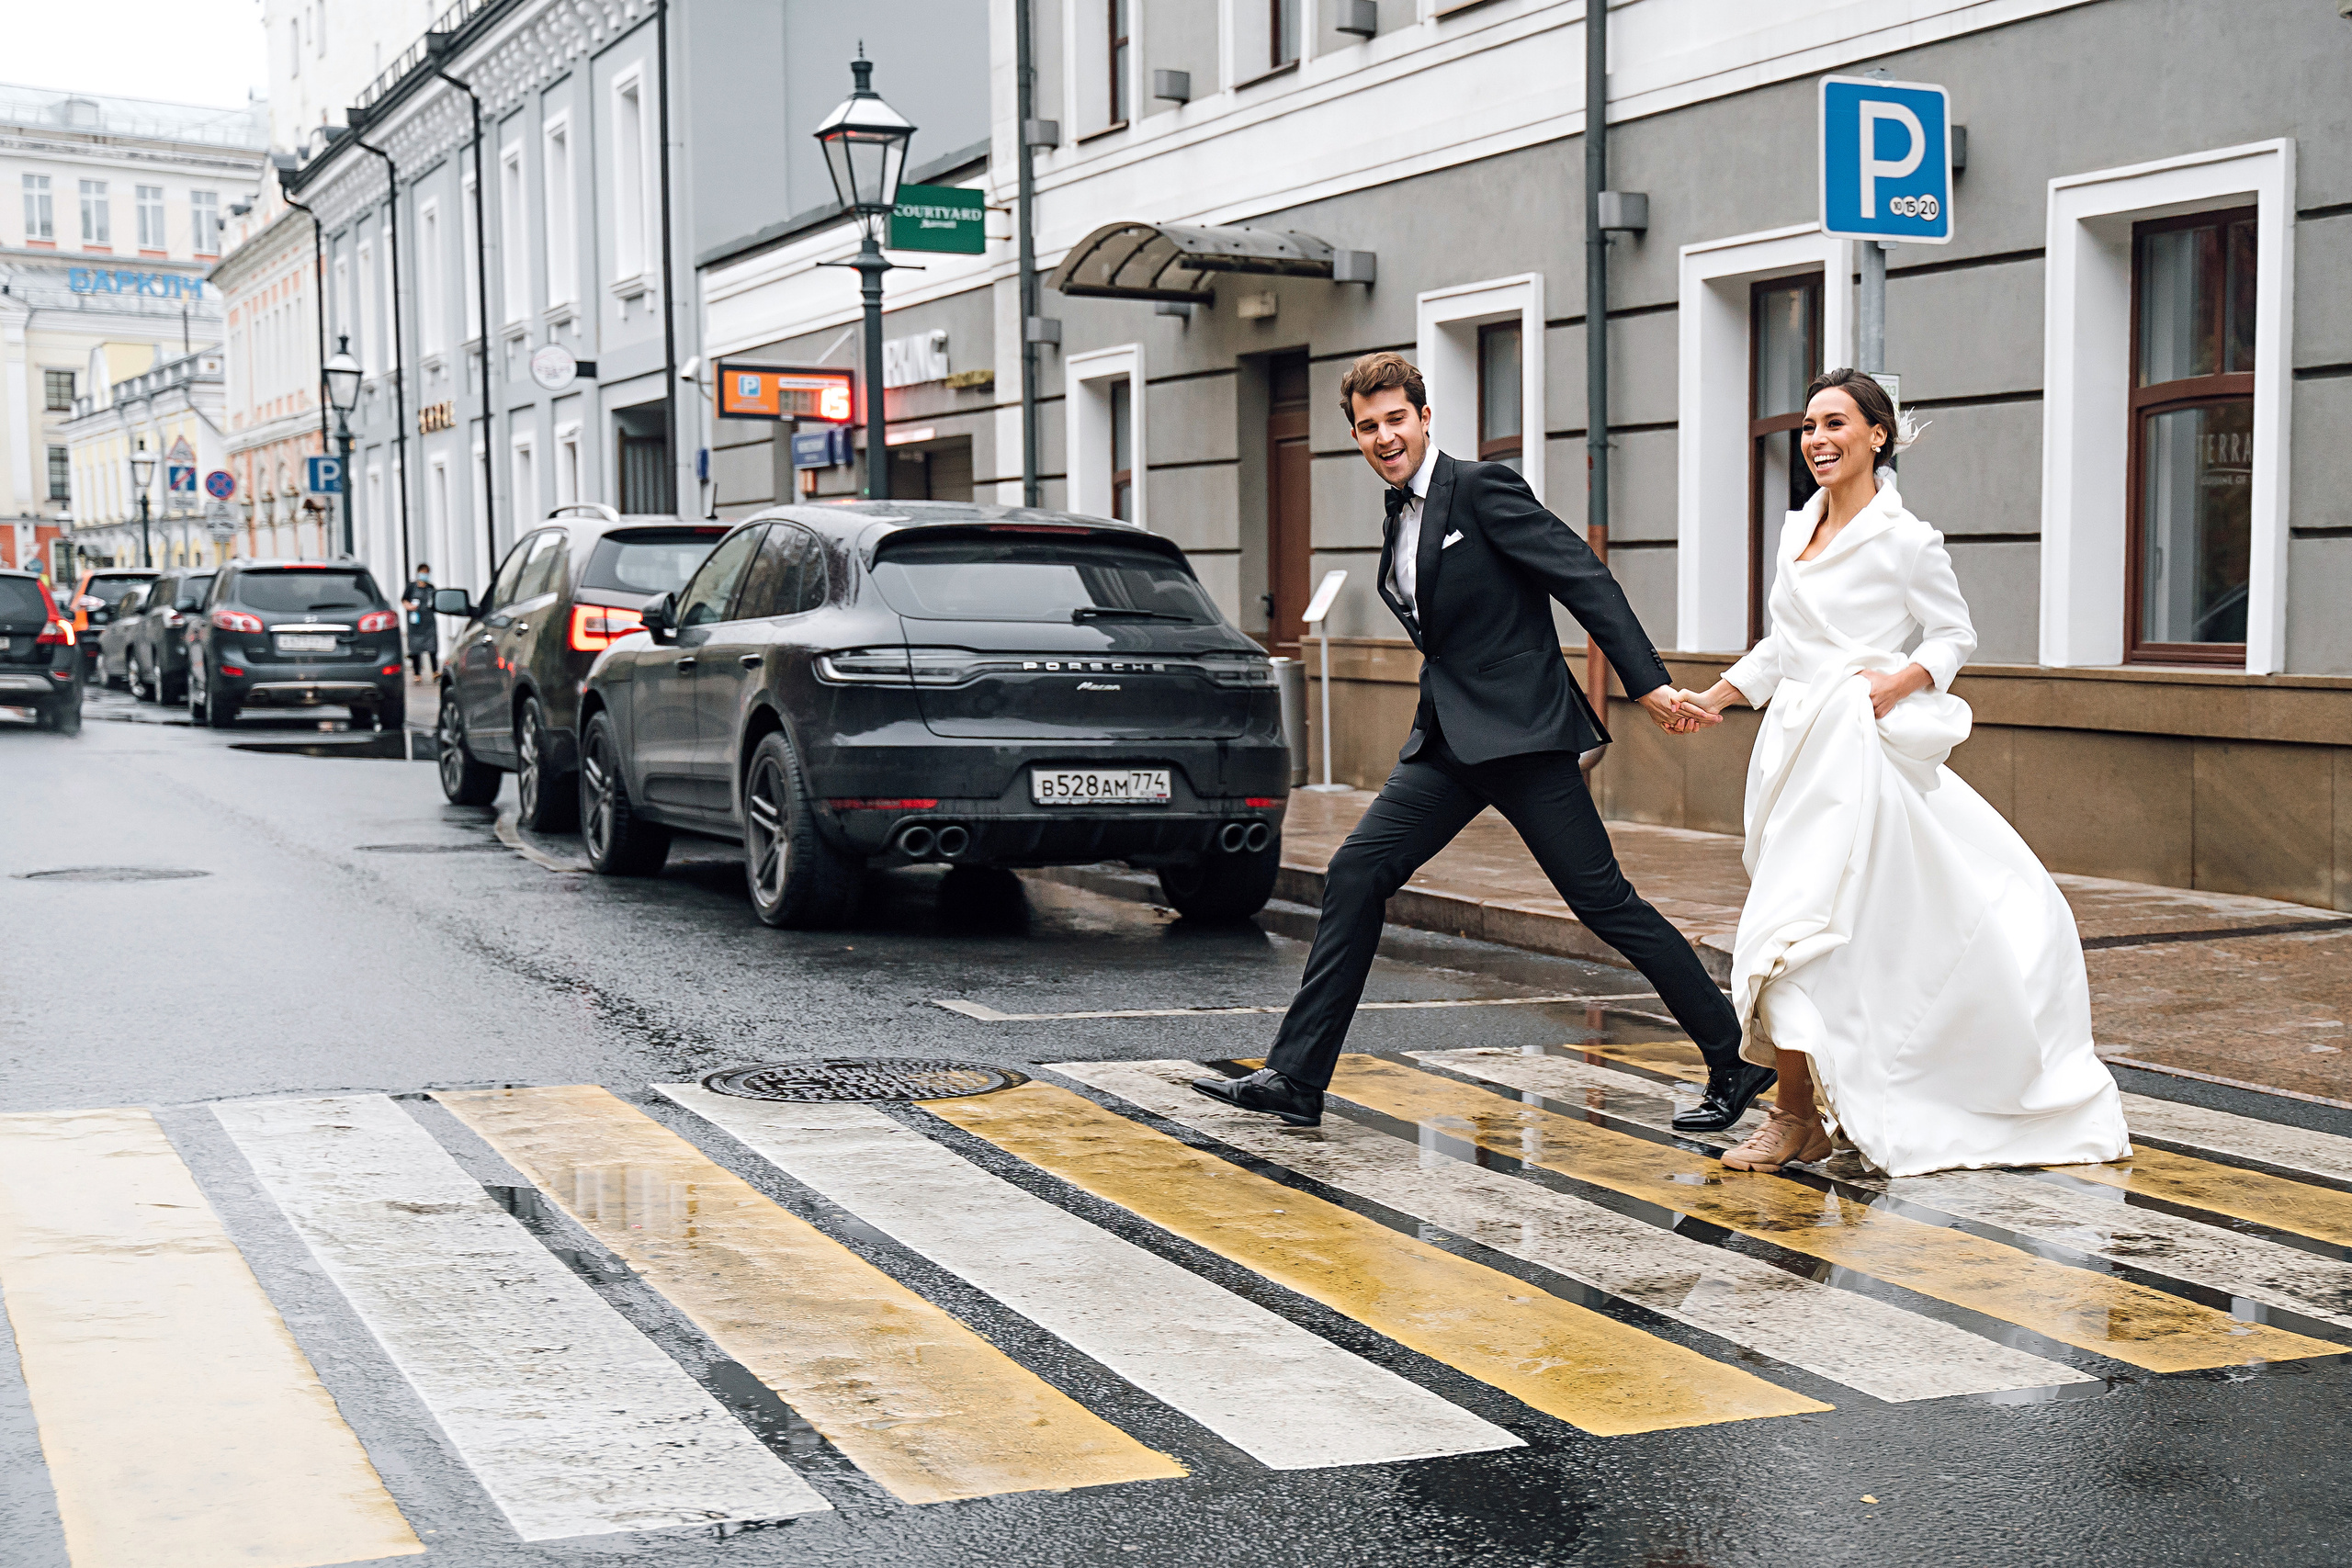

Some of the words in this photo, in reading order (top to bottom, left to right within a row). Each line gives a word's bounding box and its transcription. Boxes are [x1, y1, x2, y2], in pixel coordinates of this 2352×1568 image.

[1860, 99, 1926, 220] P
[893, 203, 983, 221] COURTYARD
[1905, 200, 1916, 213] 15
[1920, 200, 1937, 215] 20
[743, 377, 758, 396] P
[1879, 384, 1897, 396] 03
[820, 386, 850, 420] 15
[317, 459, 340, 491] P
[1023, 660, 1166, 672] PORSCHE
[1132, 773, 1166, 790] 774
